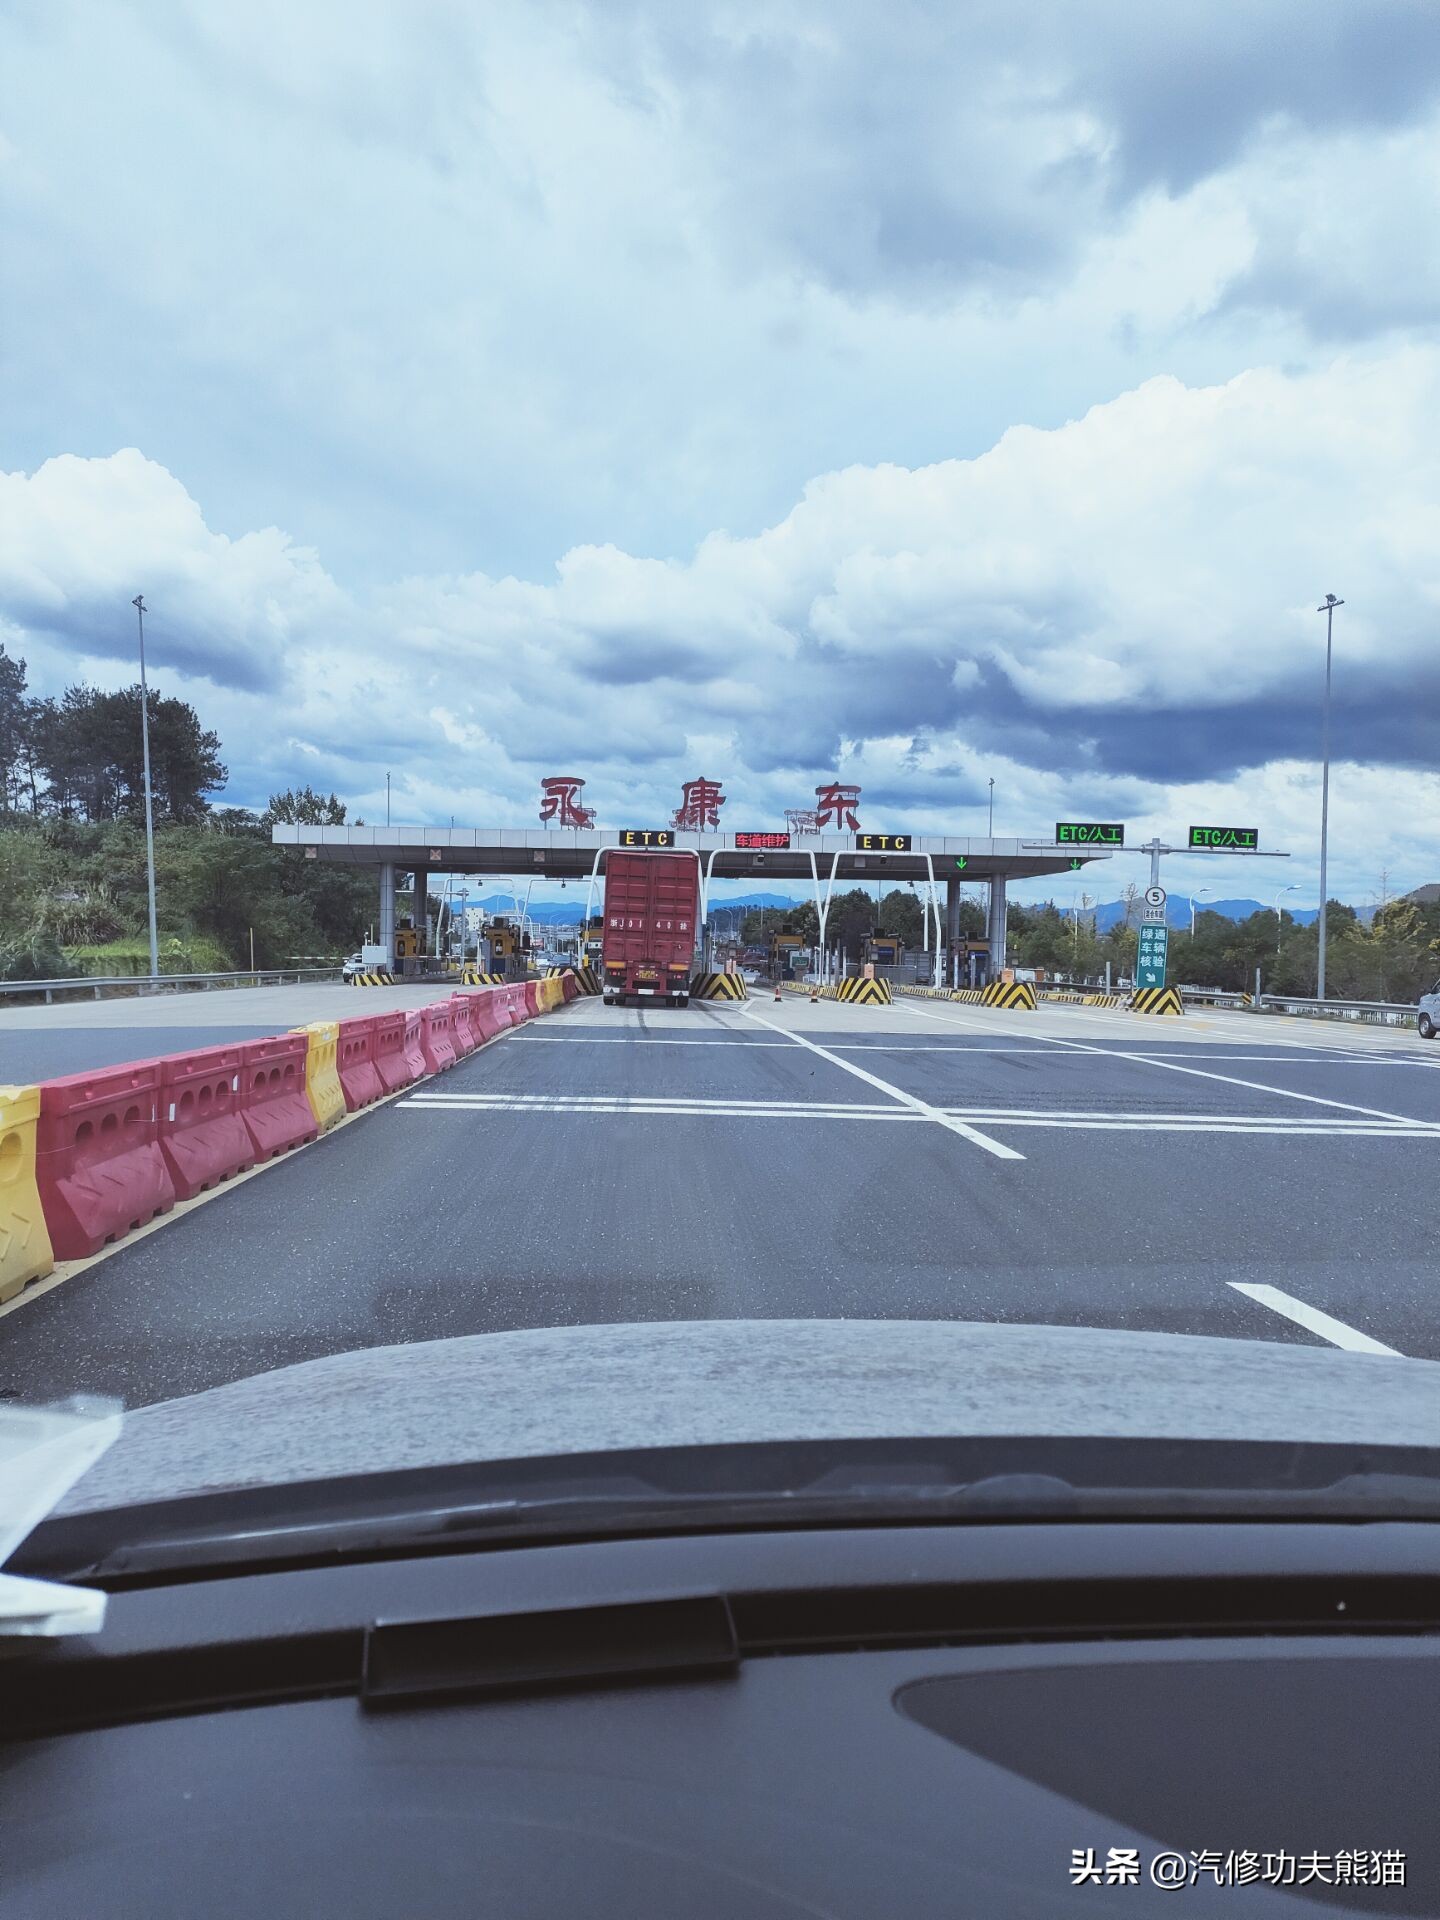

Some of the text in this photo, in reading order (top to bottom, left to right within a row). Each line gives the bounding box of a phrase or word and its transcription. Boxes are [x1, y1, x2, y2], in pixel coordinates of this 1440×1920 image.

[626, 831, 667, 846] ETC
[737, 833, 789, 848] 车道维护
[1059, 826, 1121, 841] ETC/人工
[1193, 828, 1255, 846] ETC/人工
[863, 835, 904, 850] ETC
[1152, 891, 1160, 902] 5
[1142, 928, 1166, 941] 绿通
[1140, 942, 1165, 954] 车辆
[1140, 955, 1164, 968] 核验
